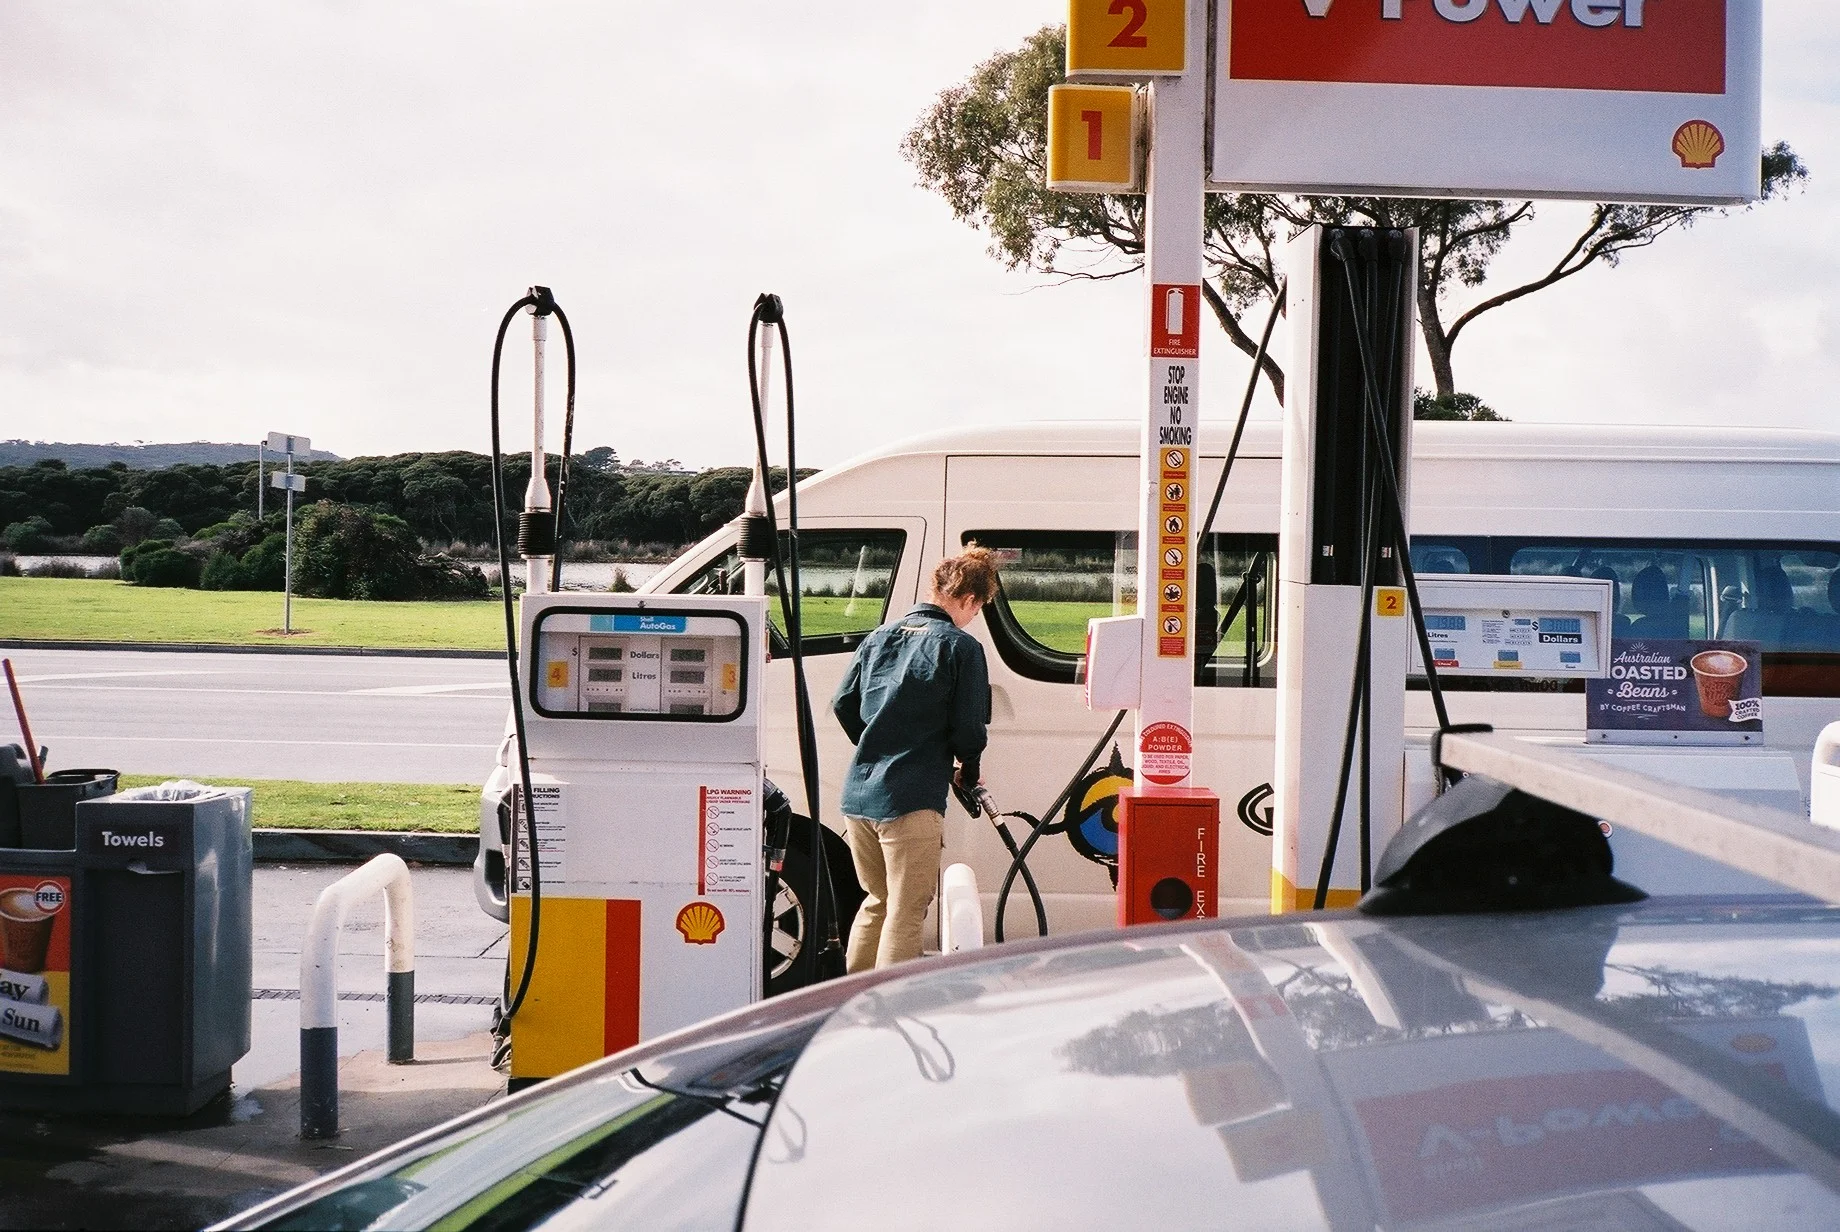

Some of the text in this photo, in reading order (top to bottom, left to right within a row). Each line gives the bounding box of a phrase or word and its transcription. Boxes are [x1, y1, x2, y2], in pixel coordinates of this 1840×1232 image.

[1106, 0, 1148, 48] 2
[1081, 110, 1102, 160] 1
[1153, 347, 1197, 355] EXTINGUISHER
[1168, 365, 1185, 384] STOP
[1163, 385, 1189, 404] ENGINE
[1170, 406, 1182, 425] NO
[1159, 426, 1192, 445] SMOKING
[1385, 595, 1397, 609] 2
[639, 621, 676, 631] AutoGas
[1531, 621, 1539, 631] $
[1542, 634, 1579, 643] Dollars
[571, 647, 578, 656] $
[630, 651, 660, 659] Dollars
[1613, 651, 1671, 664] Australian
[550, 668, 560, 680] 4
[729, 670, 736, 683] 3
[1611, 665, 1687, 680] OASTED
[1616, 681, 1670, 698] Beans
[1600, 703, 1686, 713] BY COFFEE CRAFTSMAN
[1735, 699, 1760, 710] 100%
[101, 830, 164, 848] Towels
[1196, 827, 1206, 878] FIRE
[36, 892, 62, 903] FREE
[1196, 890, 1205, 920] EX
[0, 975, 30, 1001] ay
[2, 1007, 40, 1033] Sun
